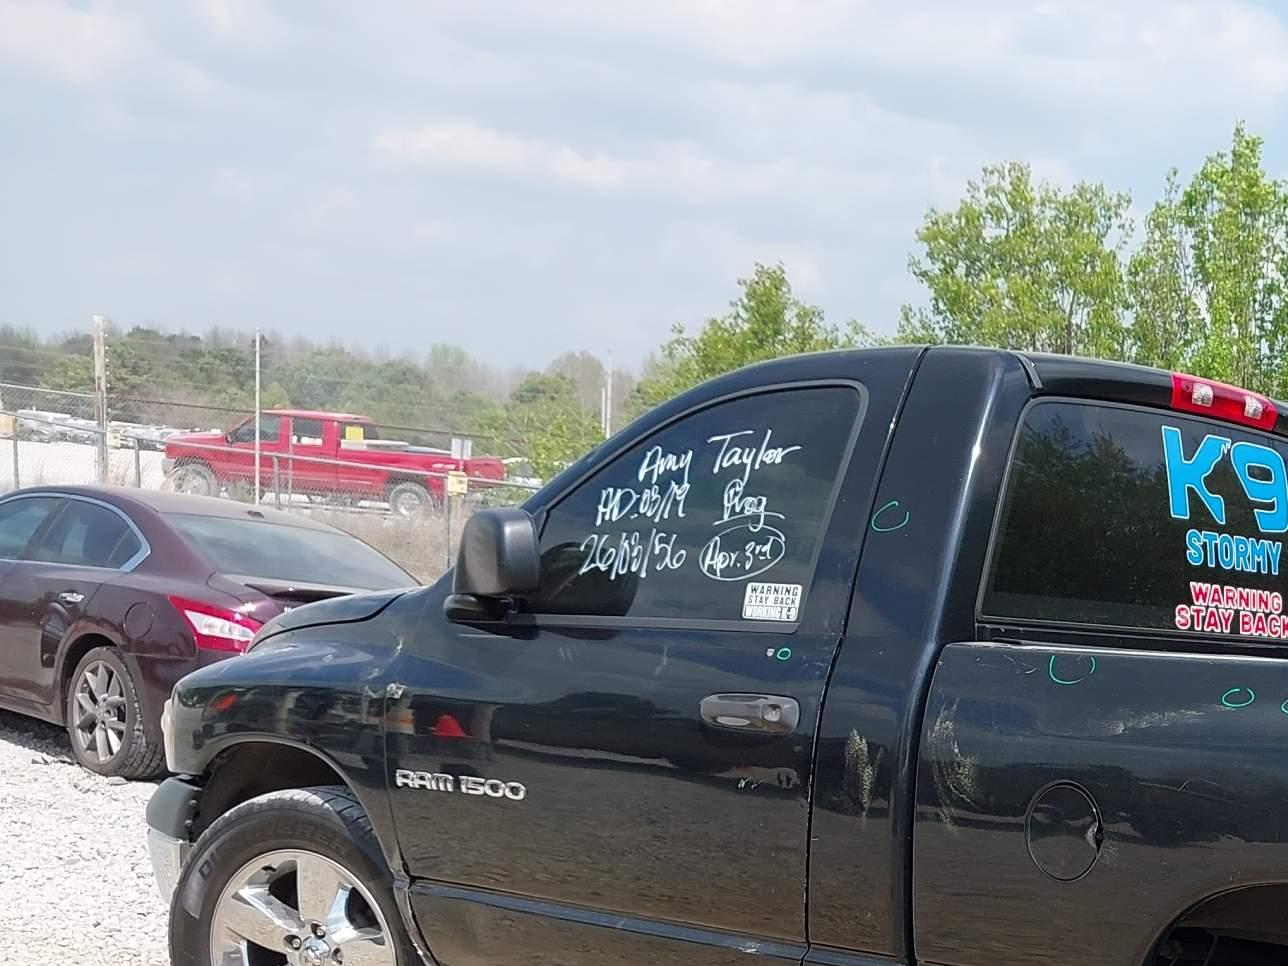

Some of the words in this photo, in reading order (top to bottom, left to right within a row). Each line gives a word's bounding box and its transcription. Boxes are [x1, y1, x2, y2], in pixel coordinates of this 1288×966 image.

[638, 446, 692, 484] Amy
[707, 428, 802, 487] Taylor
[1186, 529, 1282, 575] STORMY
[748, 595, 769, 604] STAY
[774, 596, 797, 606] BACK
[751, 584, 798, 597] WARNING
[1190, 582, 1283, 614] WARNING
[1175, 604, 1233, 633] STAY
[395, 769, 454, 792] RAM
[458, 775, 527, 801] 1500
